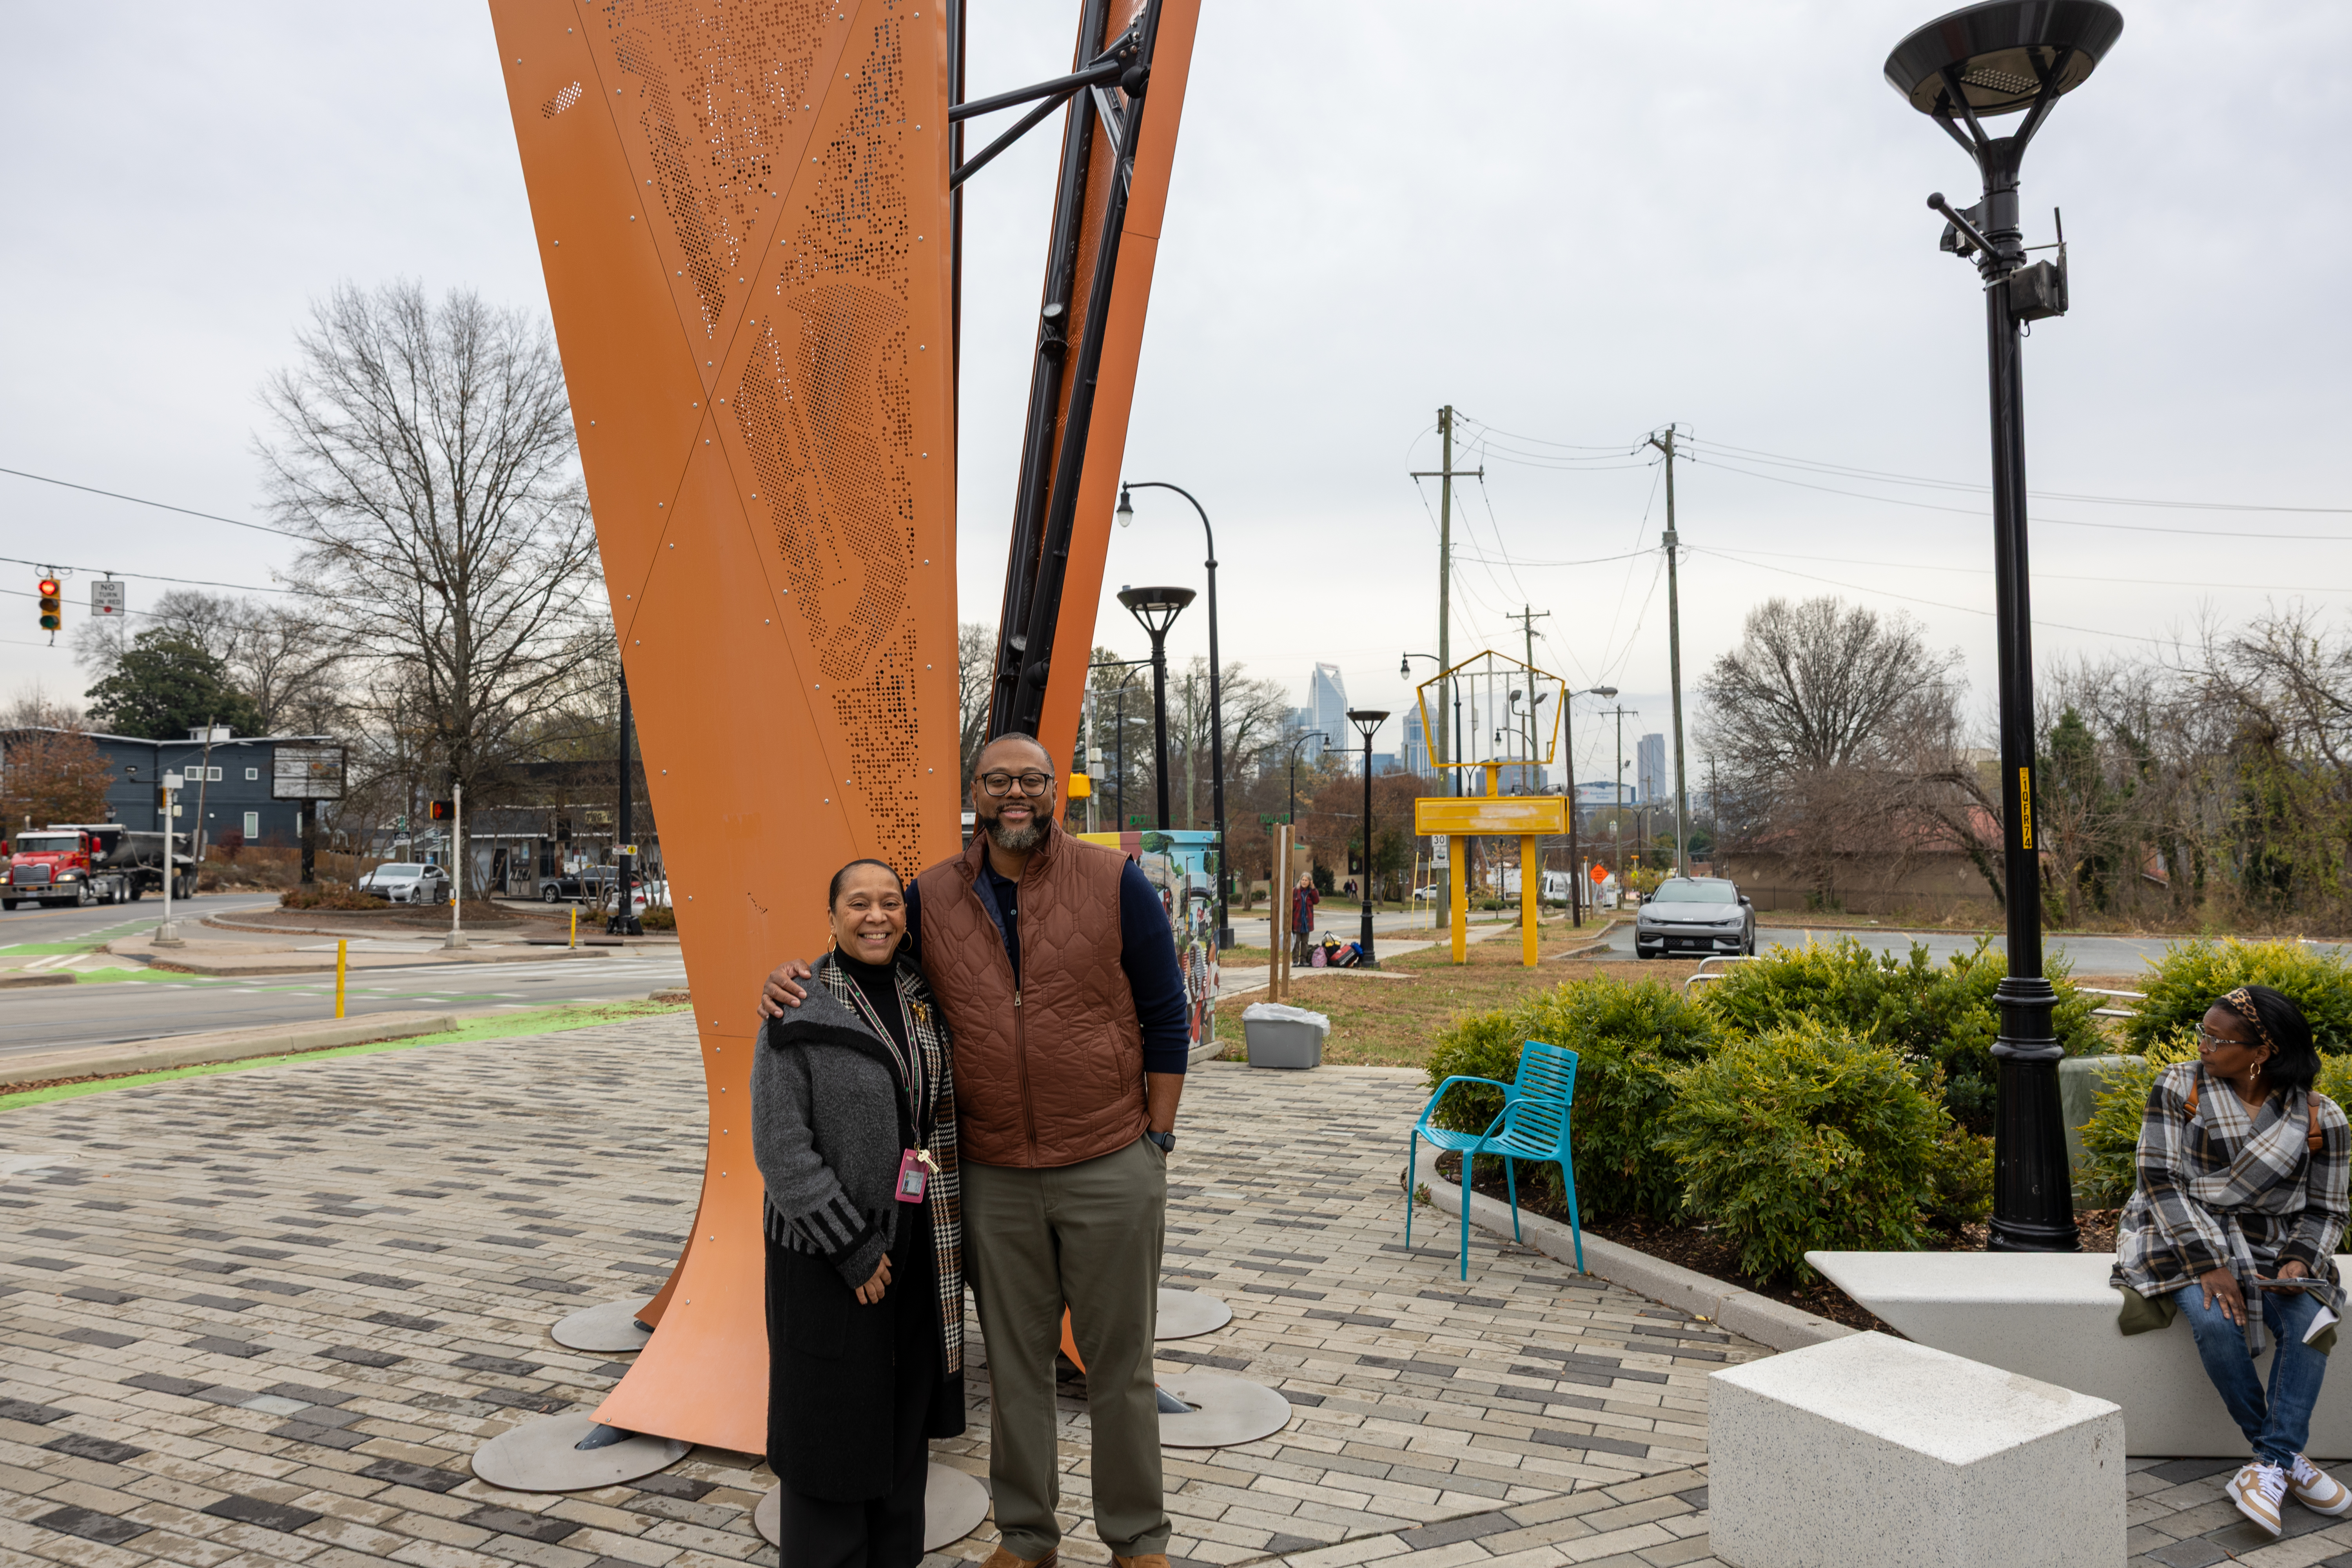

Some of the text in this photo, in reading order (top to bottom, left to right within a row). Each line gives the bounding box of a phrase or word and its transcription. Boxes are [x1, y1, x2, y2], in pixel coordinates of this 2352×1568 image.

[1130, 814, 1177, 825] DOLLR
[1260, 813, 1290, 823] DOLLAR
[2022, 780, 2031, 848] 1QFR74
[1434, 835, 1445, 844] 30
[864, 1004, 881, 1028] Marvelous
[888, 1040, 900, 1059] Atlantic
